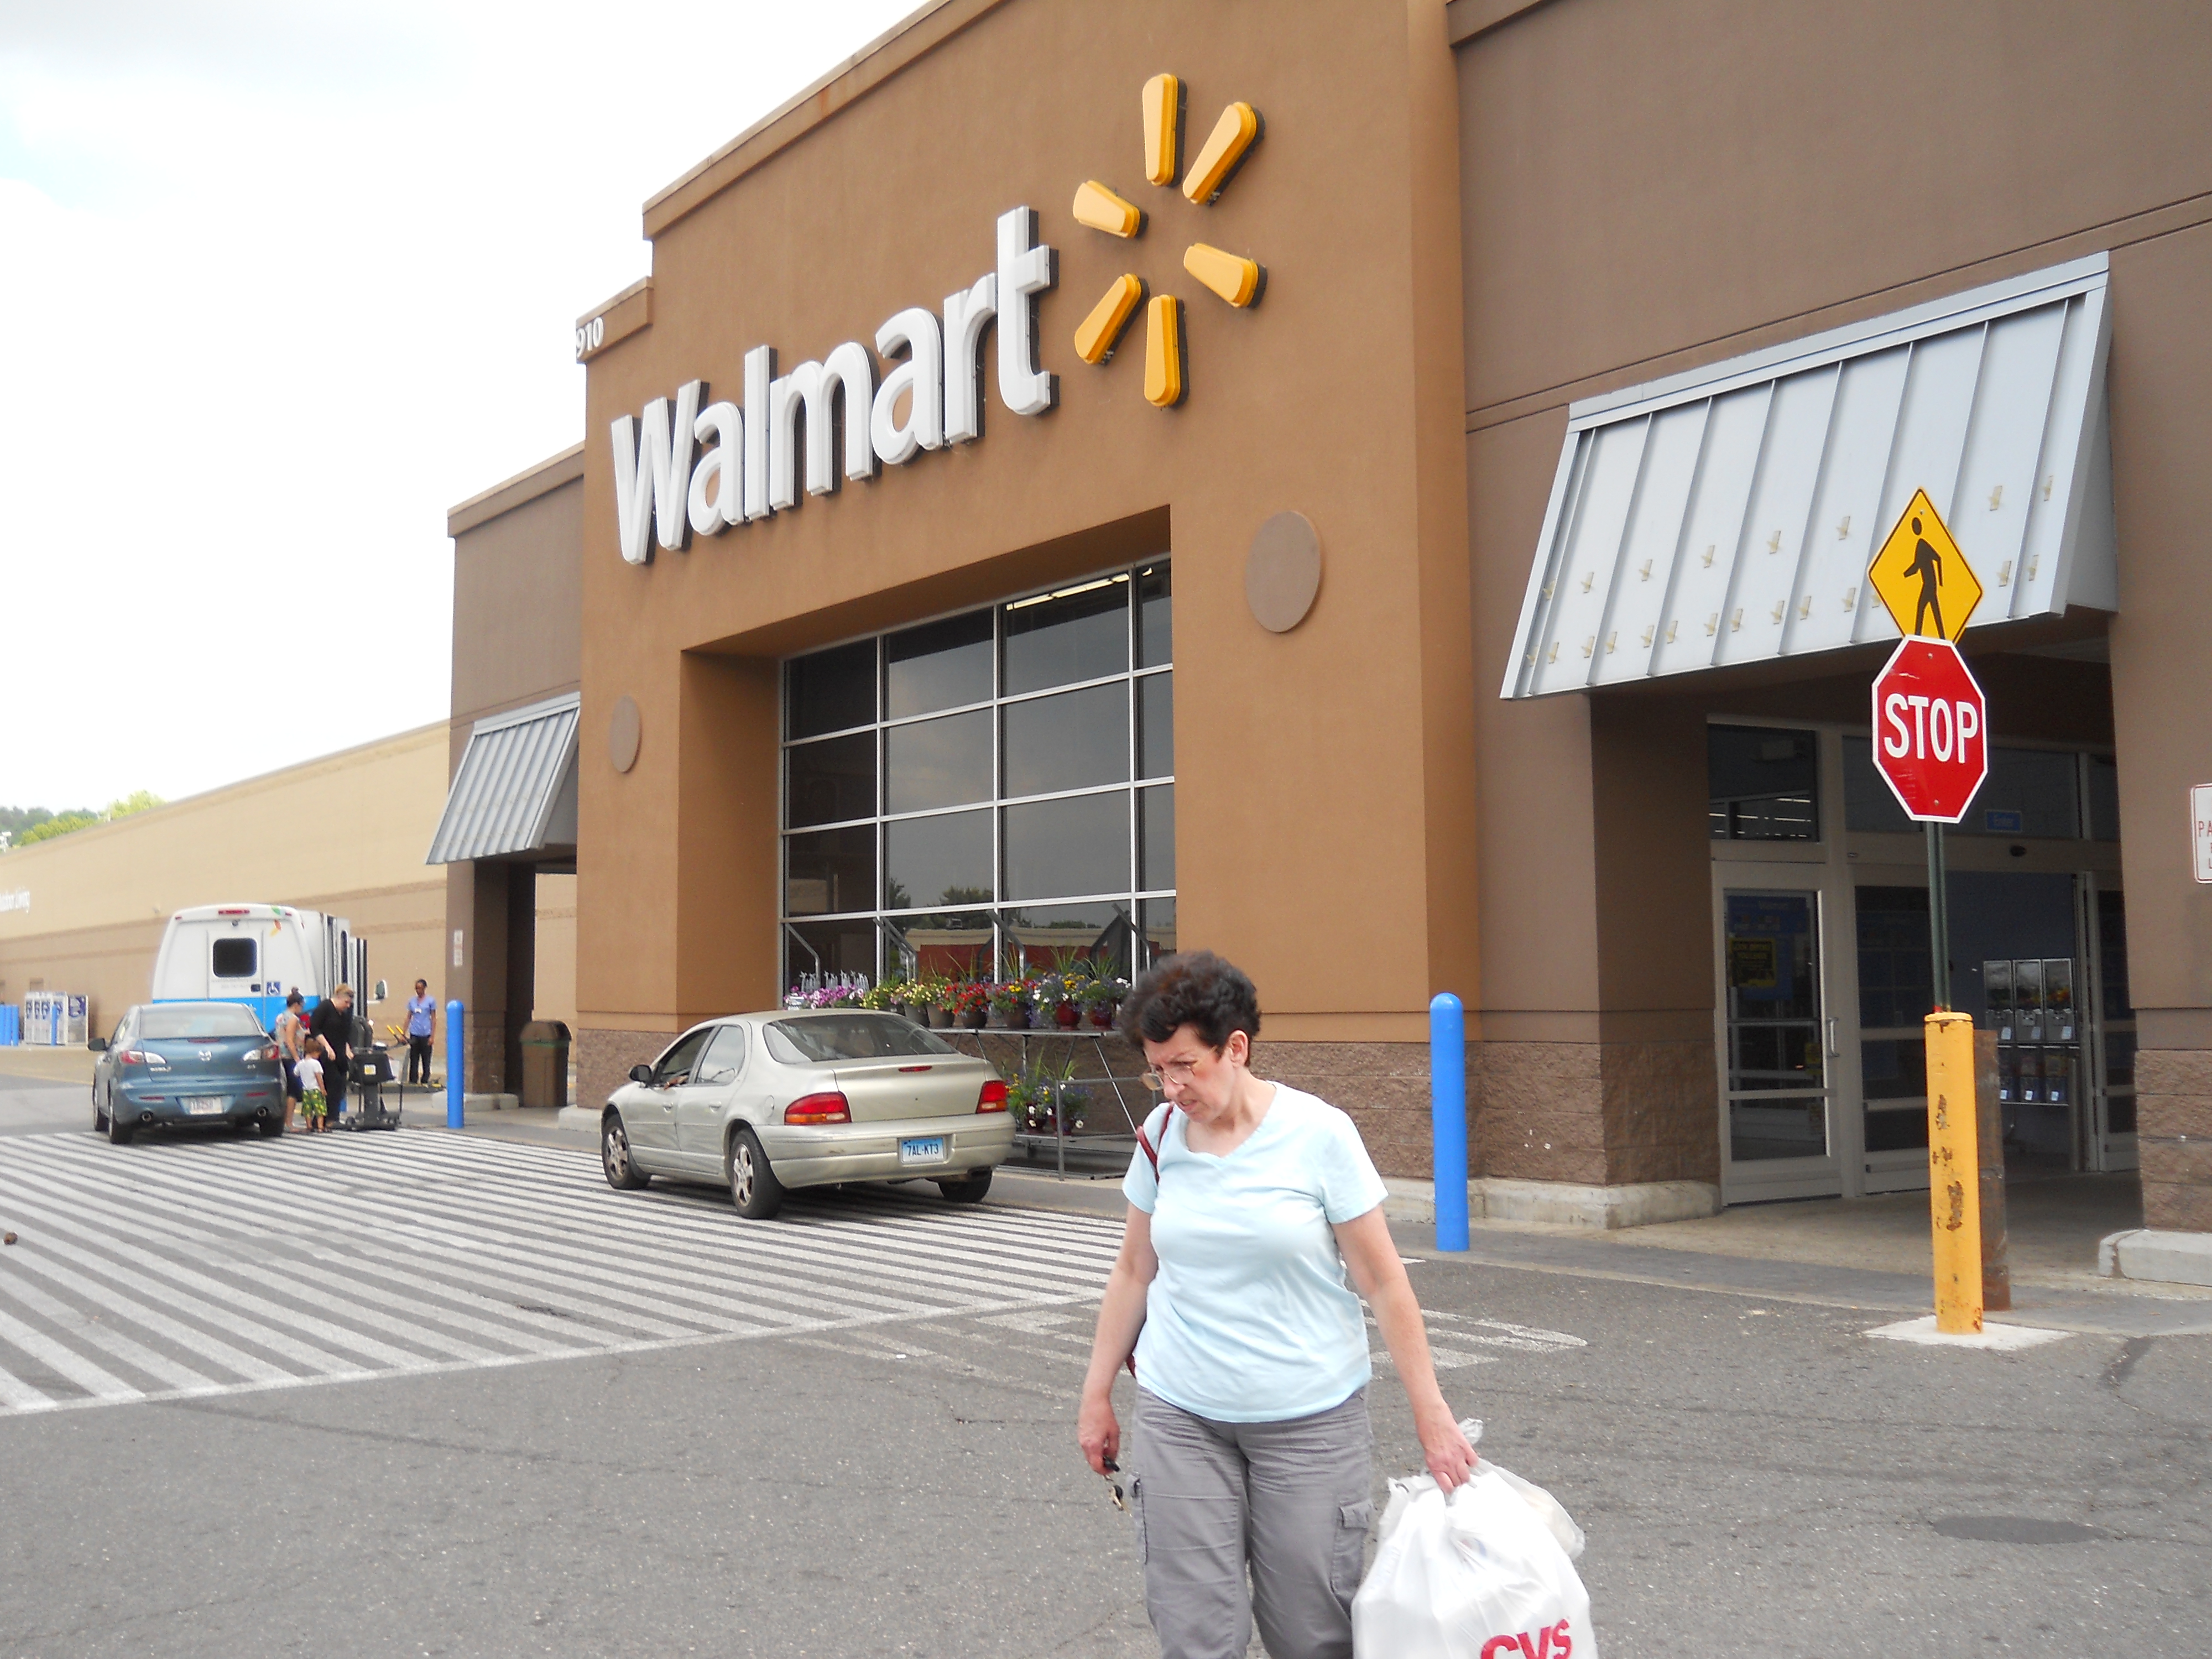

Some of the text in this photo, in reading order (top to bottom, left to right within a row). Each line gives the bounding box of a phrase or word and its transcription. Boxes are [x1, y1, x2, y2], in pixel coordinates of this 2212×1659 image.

[576, 317, 604, 358] 910
[611, 205, 1057, 565] Walmart
[1884, 693, 1978, 764] STOP
